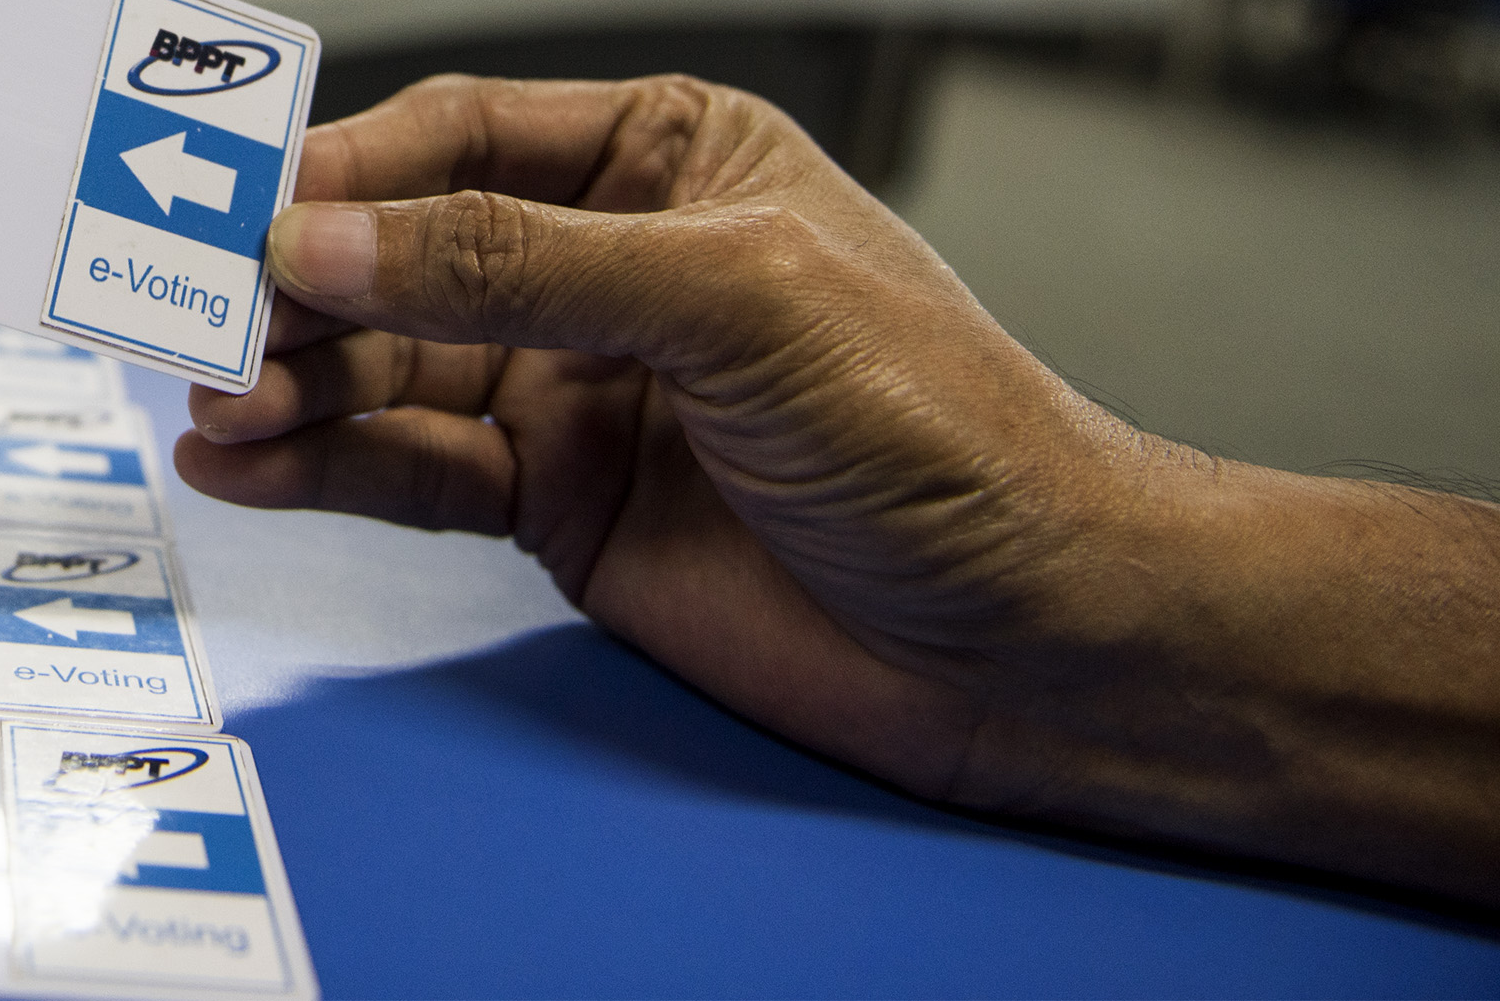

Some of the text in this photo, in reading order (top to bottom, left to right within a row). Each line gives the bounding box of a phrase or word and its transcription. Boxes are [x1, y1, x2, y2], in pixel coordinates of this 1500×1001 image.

[149, 28, 246, 84] BPPT
[88, 256, 231, 328] e-Voting
[13, 663, 168, 695] e-Voting
